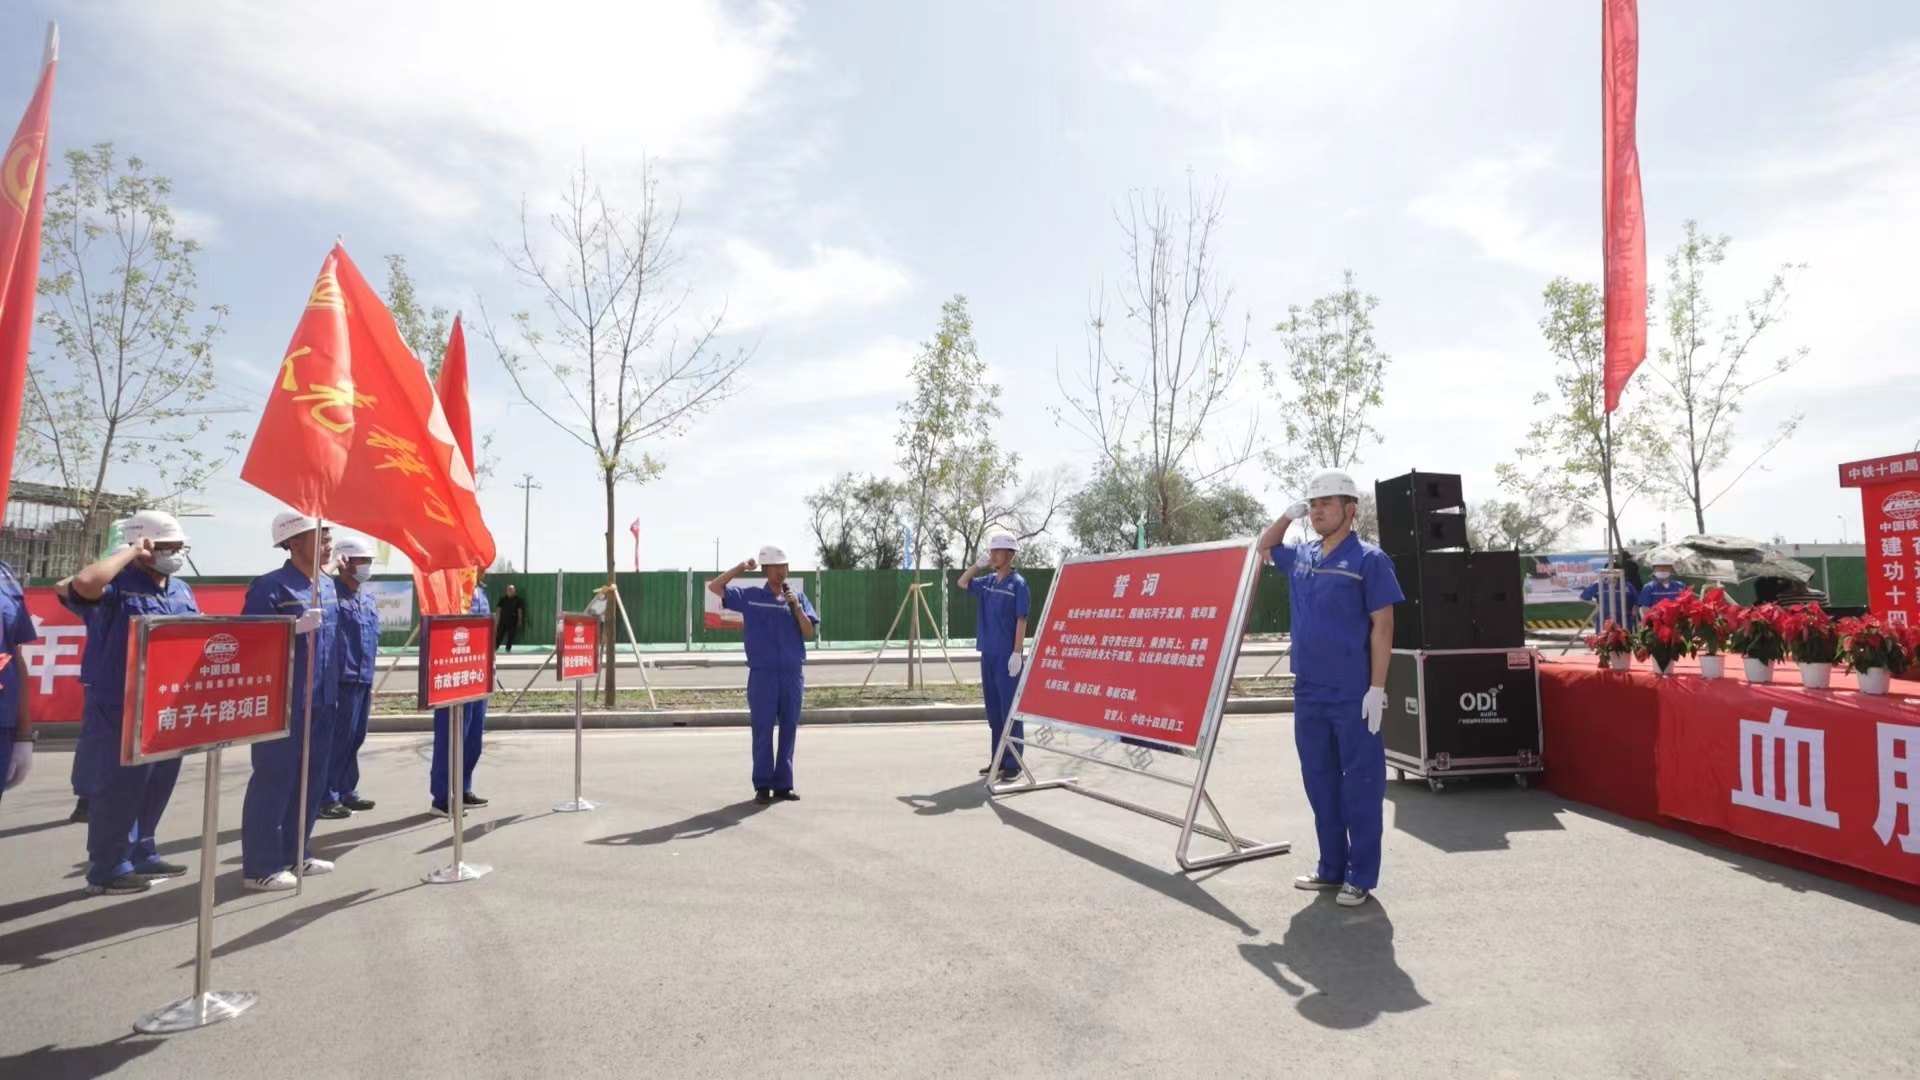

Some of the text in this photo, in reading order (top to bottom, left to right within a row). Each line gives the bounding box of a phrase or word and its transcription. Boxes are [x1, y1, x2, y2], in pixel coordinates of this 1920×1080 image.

[1113, 573, 1160, 598] 誓词
[199, 663, 241, 677] 中国铁建
[433, 668, 485, 691] 市政管理中心
[157, 695, 269, 731] 南子午路项目
